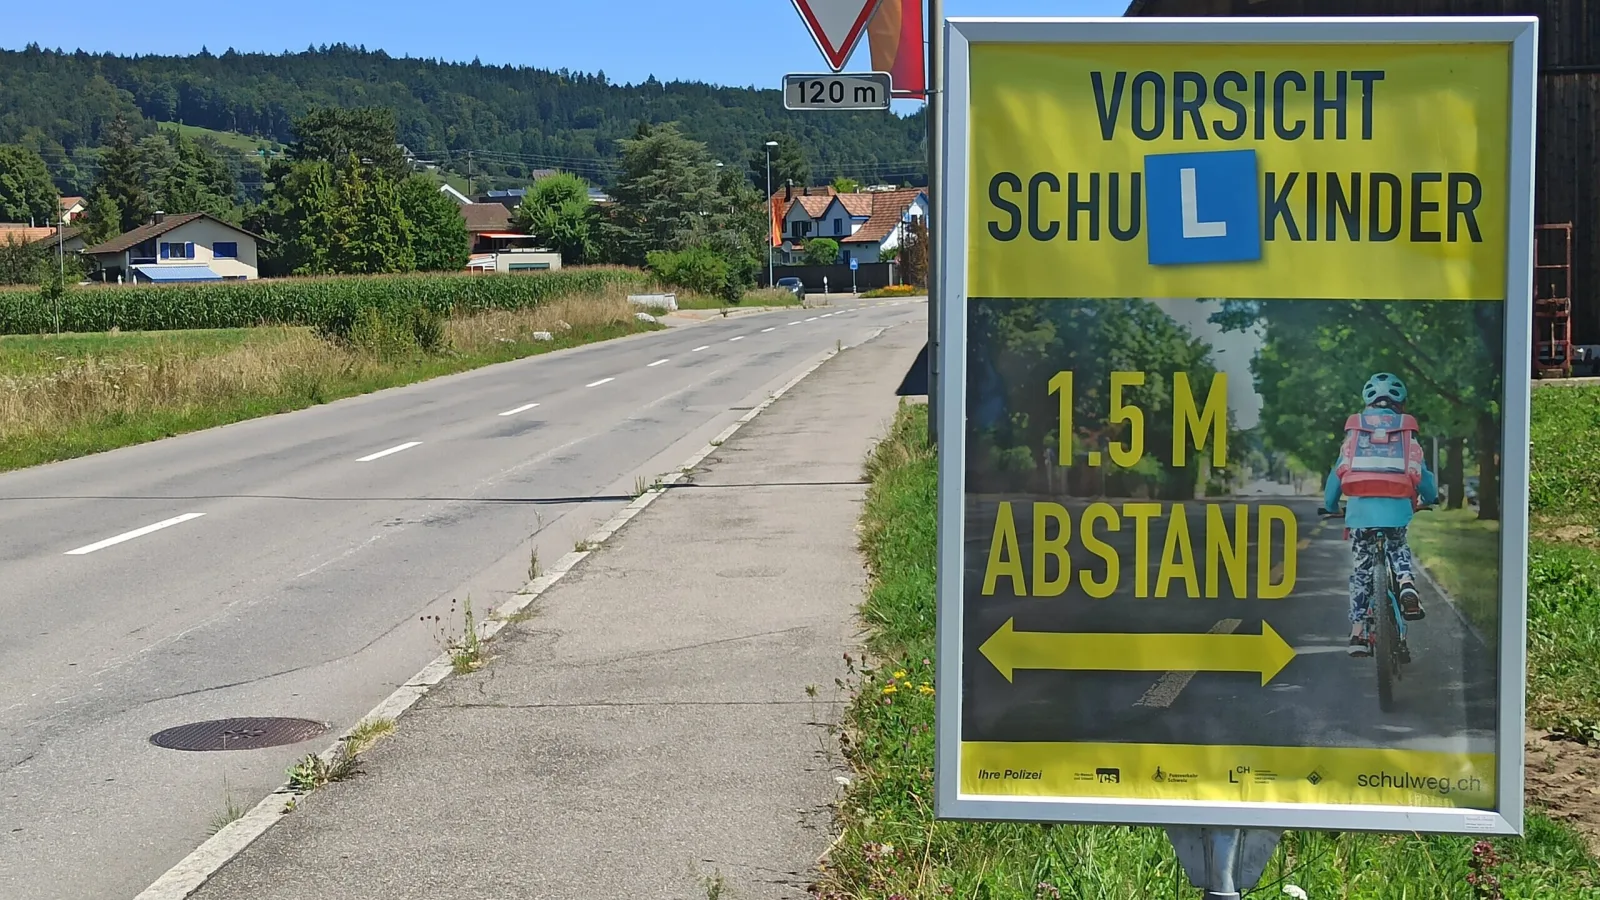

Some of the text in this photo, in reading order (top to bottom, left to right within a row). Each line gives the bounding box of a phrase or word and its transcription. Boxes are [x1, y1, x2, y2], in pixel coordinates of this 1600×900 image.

[798, 80, 876, 103] 120 m
[1090, 70, 1385, 141] VORSICHT
[1047, 370, 1228, 468] 1.5 M
[981, 501, 1298, 599] ABSTAND
[978, 769, 1042, 780] Ihre Polizei
[1357, 771, 1481, 794] schulweg.ch
